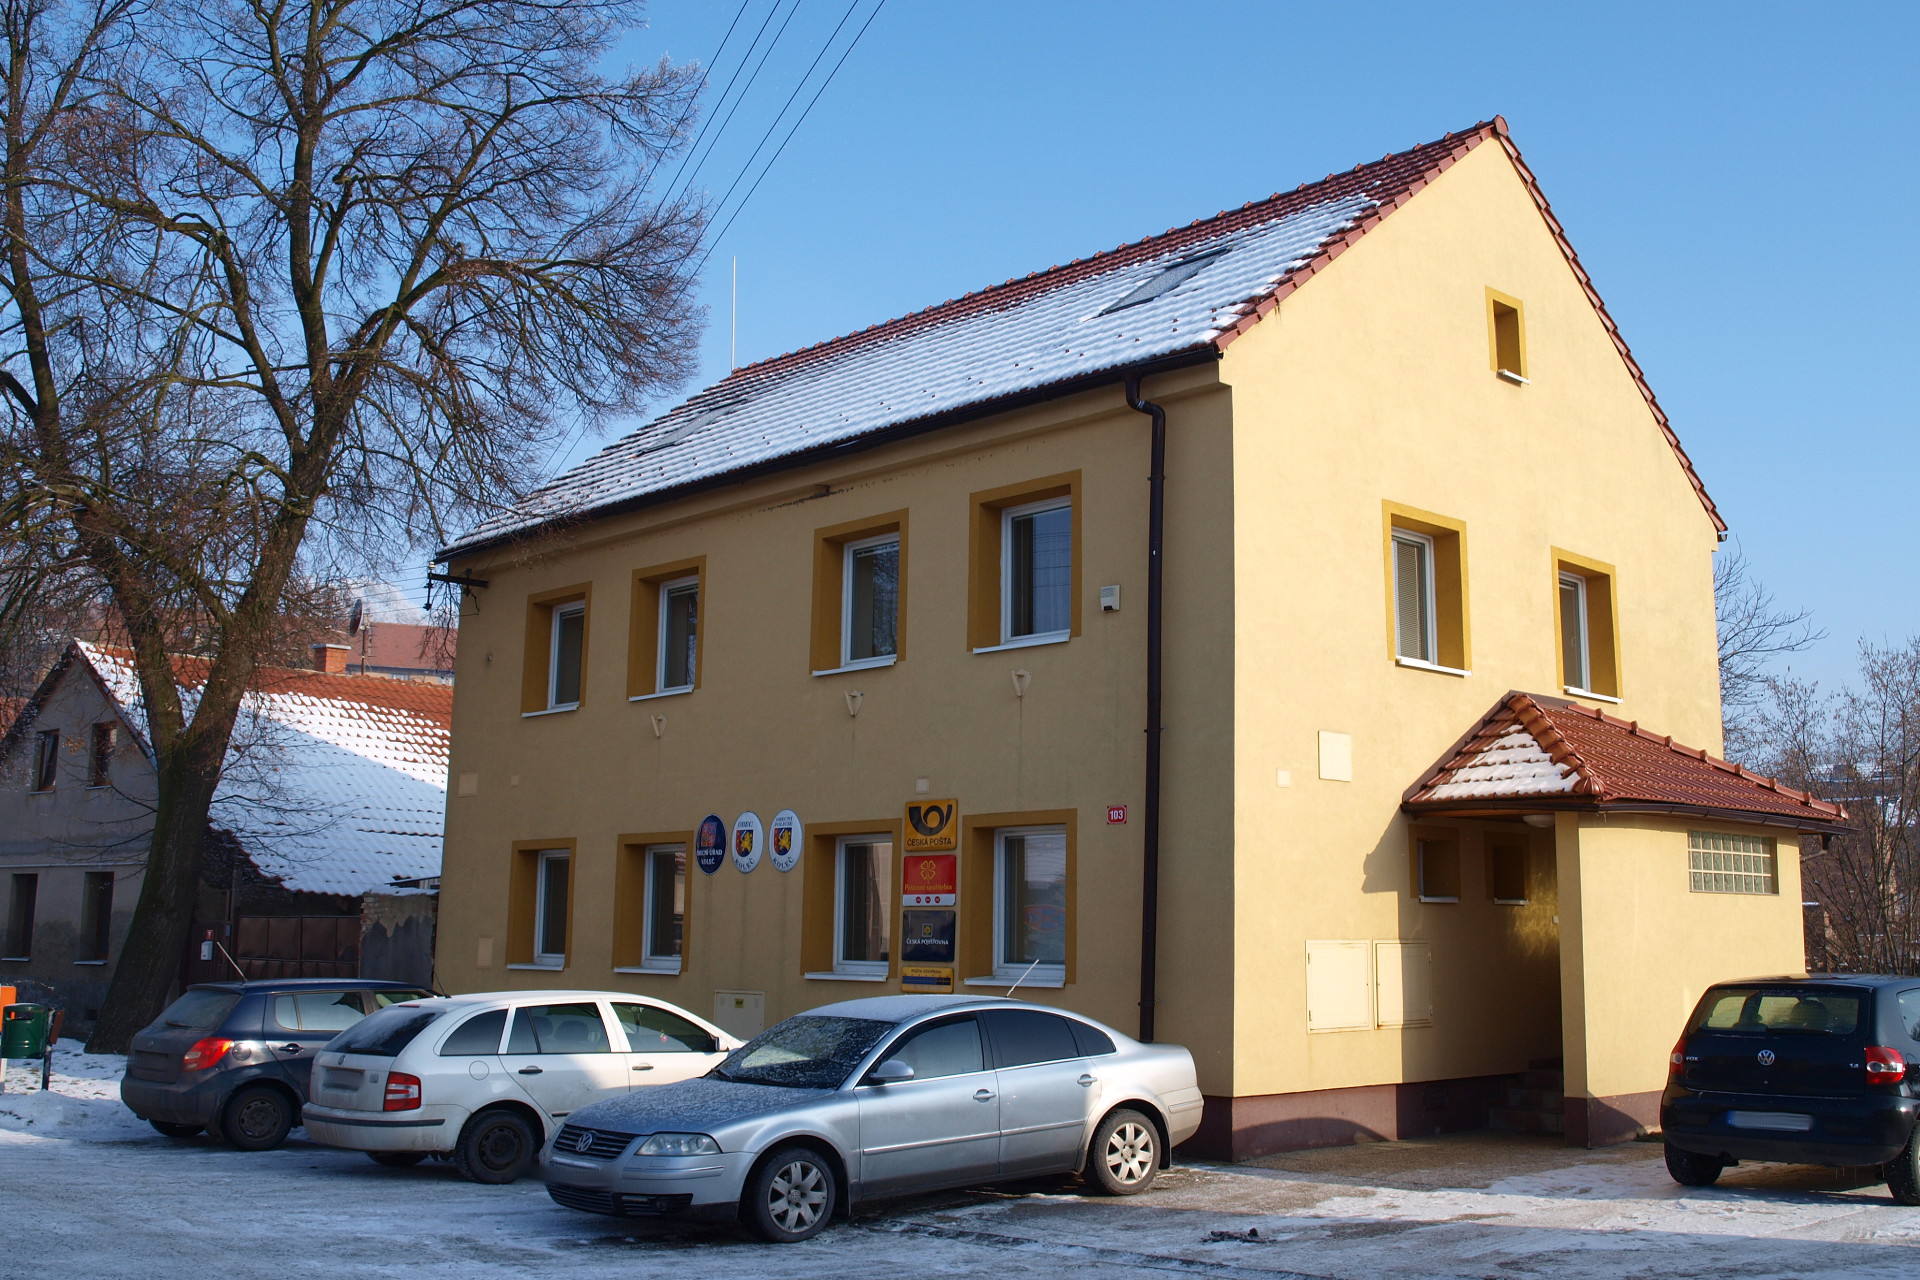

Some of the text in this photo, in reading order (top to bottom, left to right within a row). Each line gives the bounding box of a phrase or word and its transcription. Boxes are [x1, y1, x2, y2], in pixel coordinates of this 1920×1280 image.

[1110, 810, 1123, 820] 103
[907, 836, 951, 846] ČESKÁ POŠTA
[735, 858, 755, 870] KOLEČ
[773, 856, 793, 869] KOLEČ
